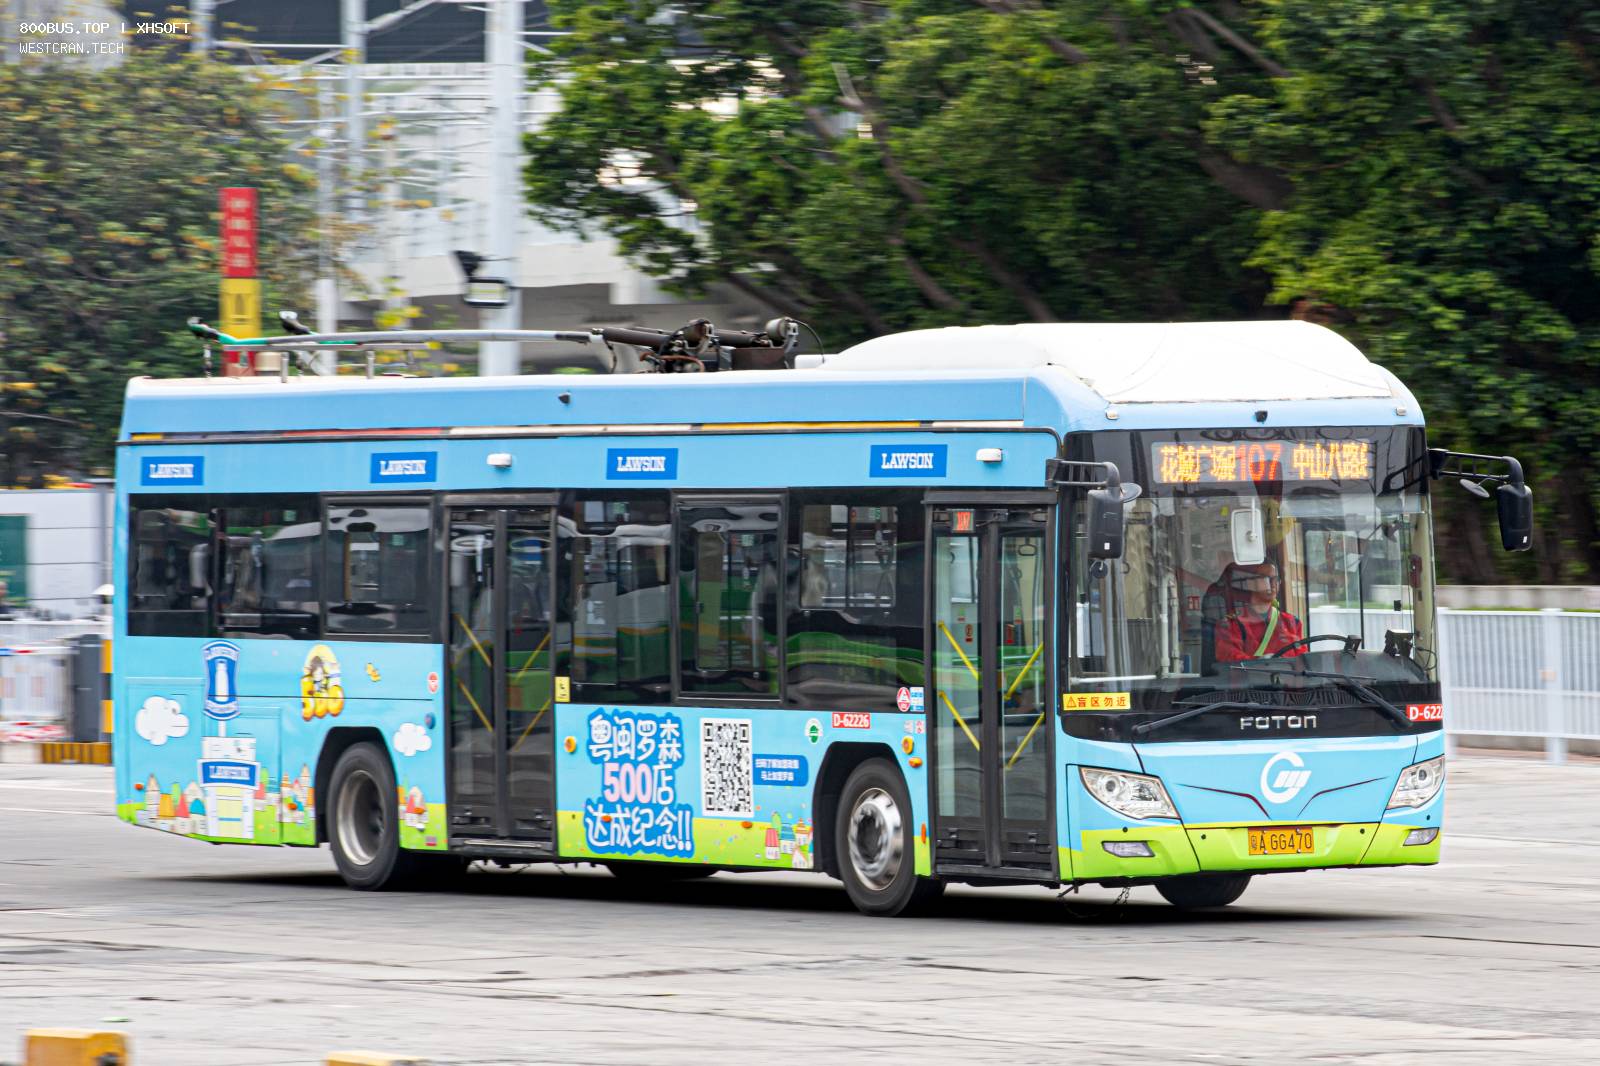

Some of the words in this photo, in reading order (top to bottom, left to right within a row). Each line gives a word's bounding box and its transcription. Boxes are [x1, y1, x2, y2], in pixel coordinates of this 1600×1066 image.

[379, 459, 426, 476] LAWSON
[616, 456, 666, 472] LAWSON
[881, 452, 934, 469] LAWSON
[1237, 443, 1283, 481] 107
[149, 463, 194, 478] LAWSON
[1077, 696, 1126, 708] 盲区勿近
[833, 713, 870, 728] D-62226
[1240, 714, 1317, 730] FOTON
[588, 714, 682, 762] 粤闽罗森
[603, 760, 674, 805] 500店
